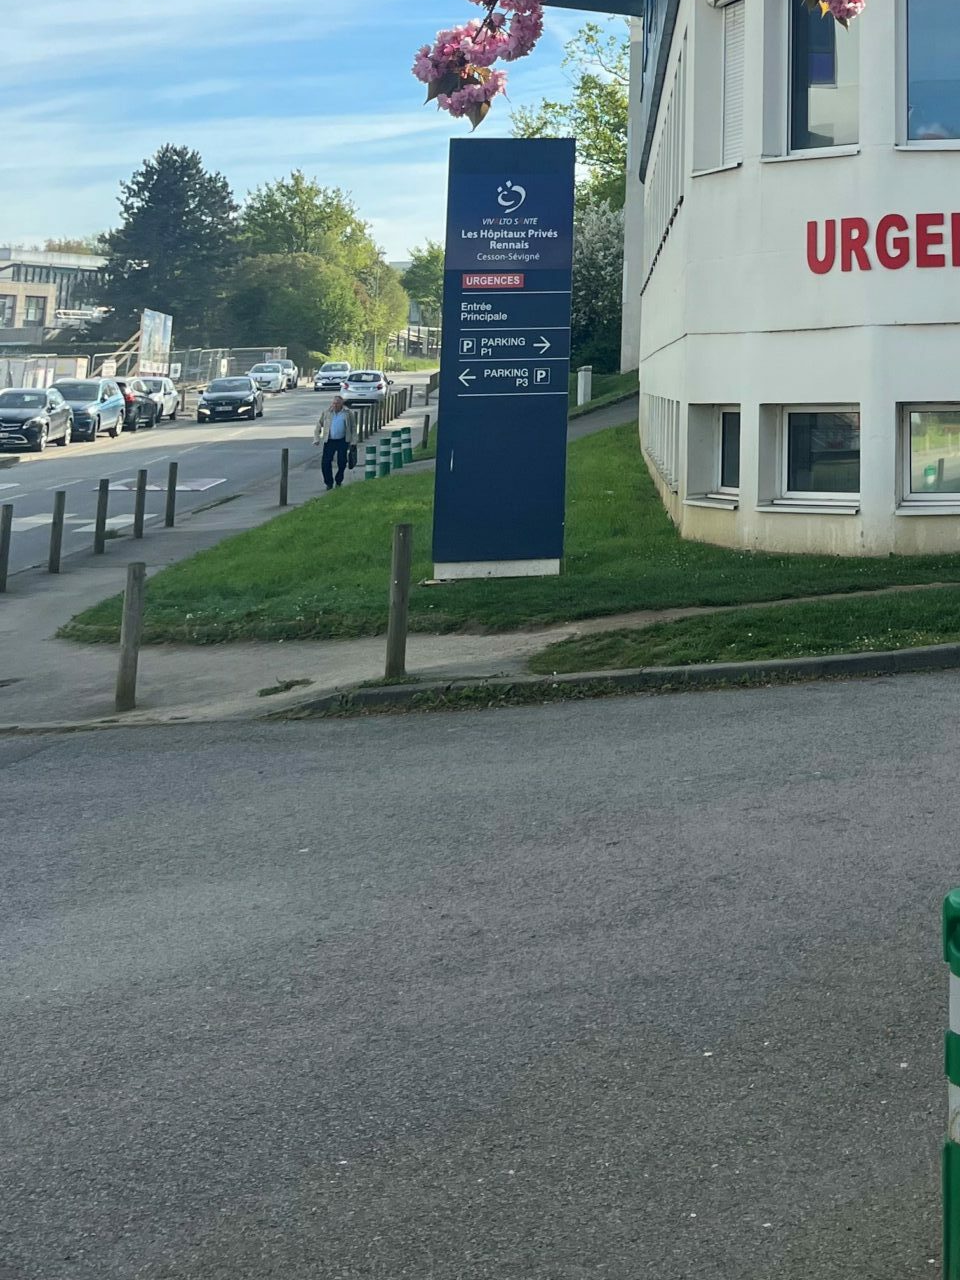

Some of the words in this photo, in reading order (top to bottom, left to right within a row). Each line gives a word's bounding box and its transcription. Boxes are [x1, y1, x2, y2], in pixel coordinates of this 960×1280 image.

[513, 217, 538, 225] SNTE
[461, 229, 478, 239] Les
[480, 229, 526, 240] Hôpitaux
[528, 228, 558, 239] Privés
[489, 240, 530, 250] Rennais
[476, 252, 541, 262] Cesson-Sévigné
[466, 276, 520, 286] URGENCES
[461, 302, 492, 311] Entrée
[461, 312, 508, 322] Principale
[463, 340, 473, 353] P
[481, 337, 526, 347] PARKING
[480, 348, 492, 356] P1
[484, 368, 529, 378] PARKING
[536, 370, 547, 382] P
[515, 378, 529, 387] P3
